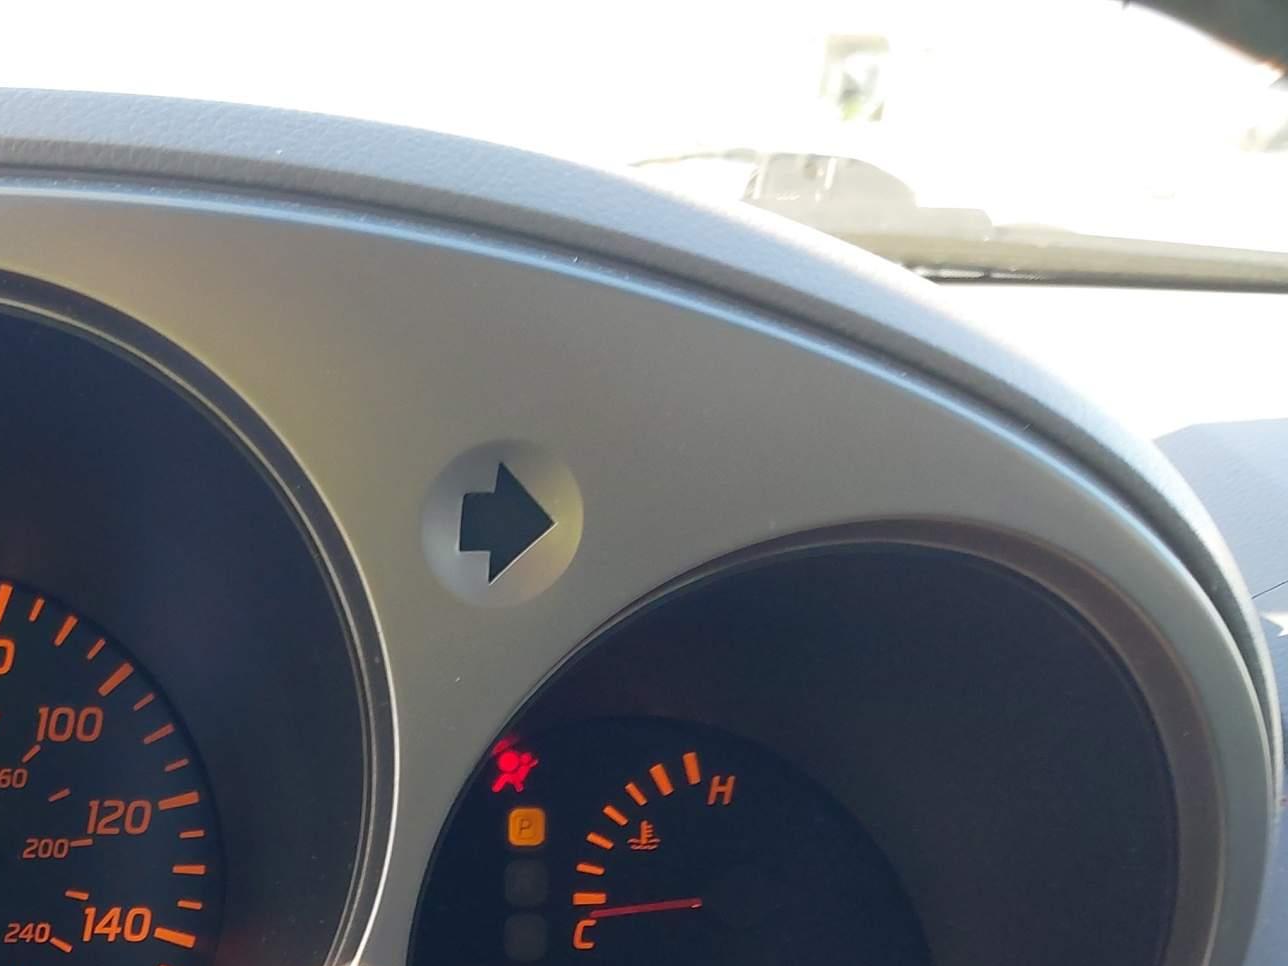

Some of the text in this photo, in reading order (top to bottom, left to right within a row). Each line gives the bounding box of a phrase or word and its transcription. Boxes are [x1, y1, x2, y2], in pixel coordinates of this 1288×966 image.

[35, 706, 104, 743] 100
[708, 776, 736, 804] H
[87, 799, 152, 835] 120
[22, 838, 69, 859] 200
[4, 922, 51, 944] 240
[82, 906, 152, 943] 140
[574, 919, 597, 949] C
